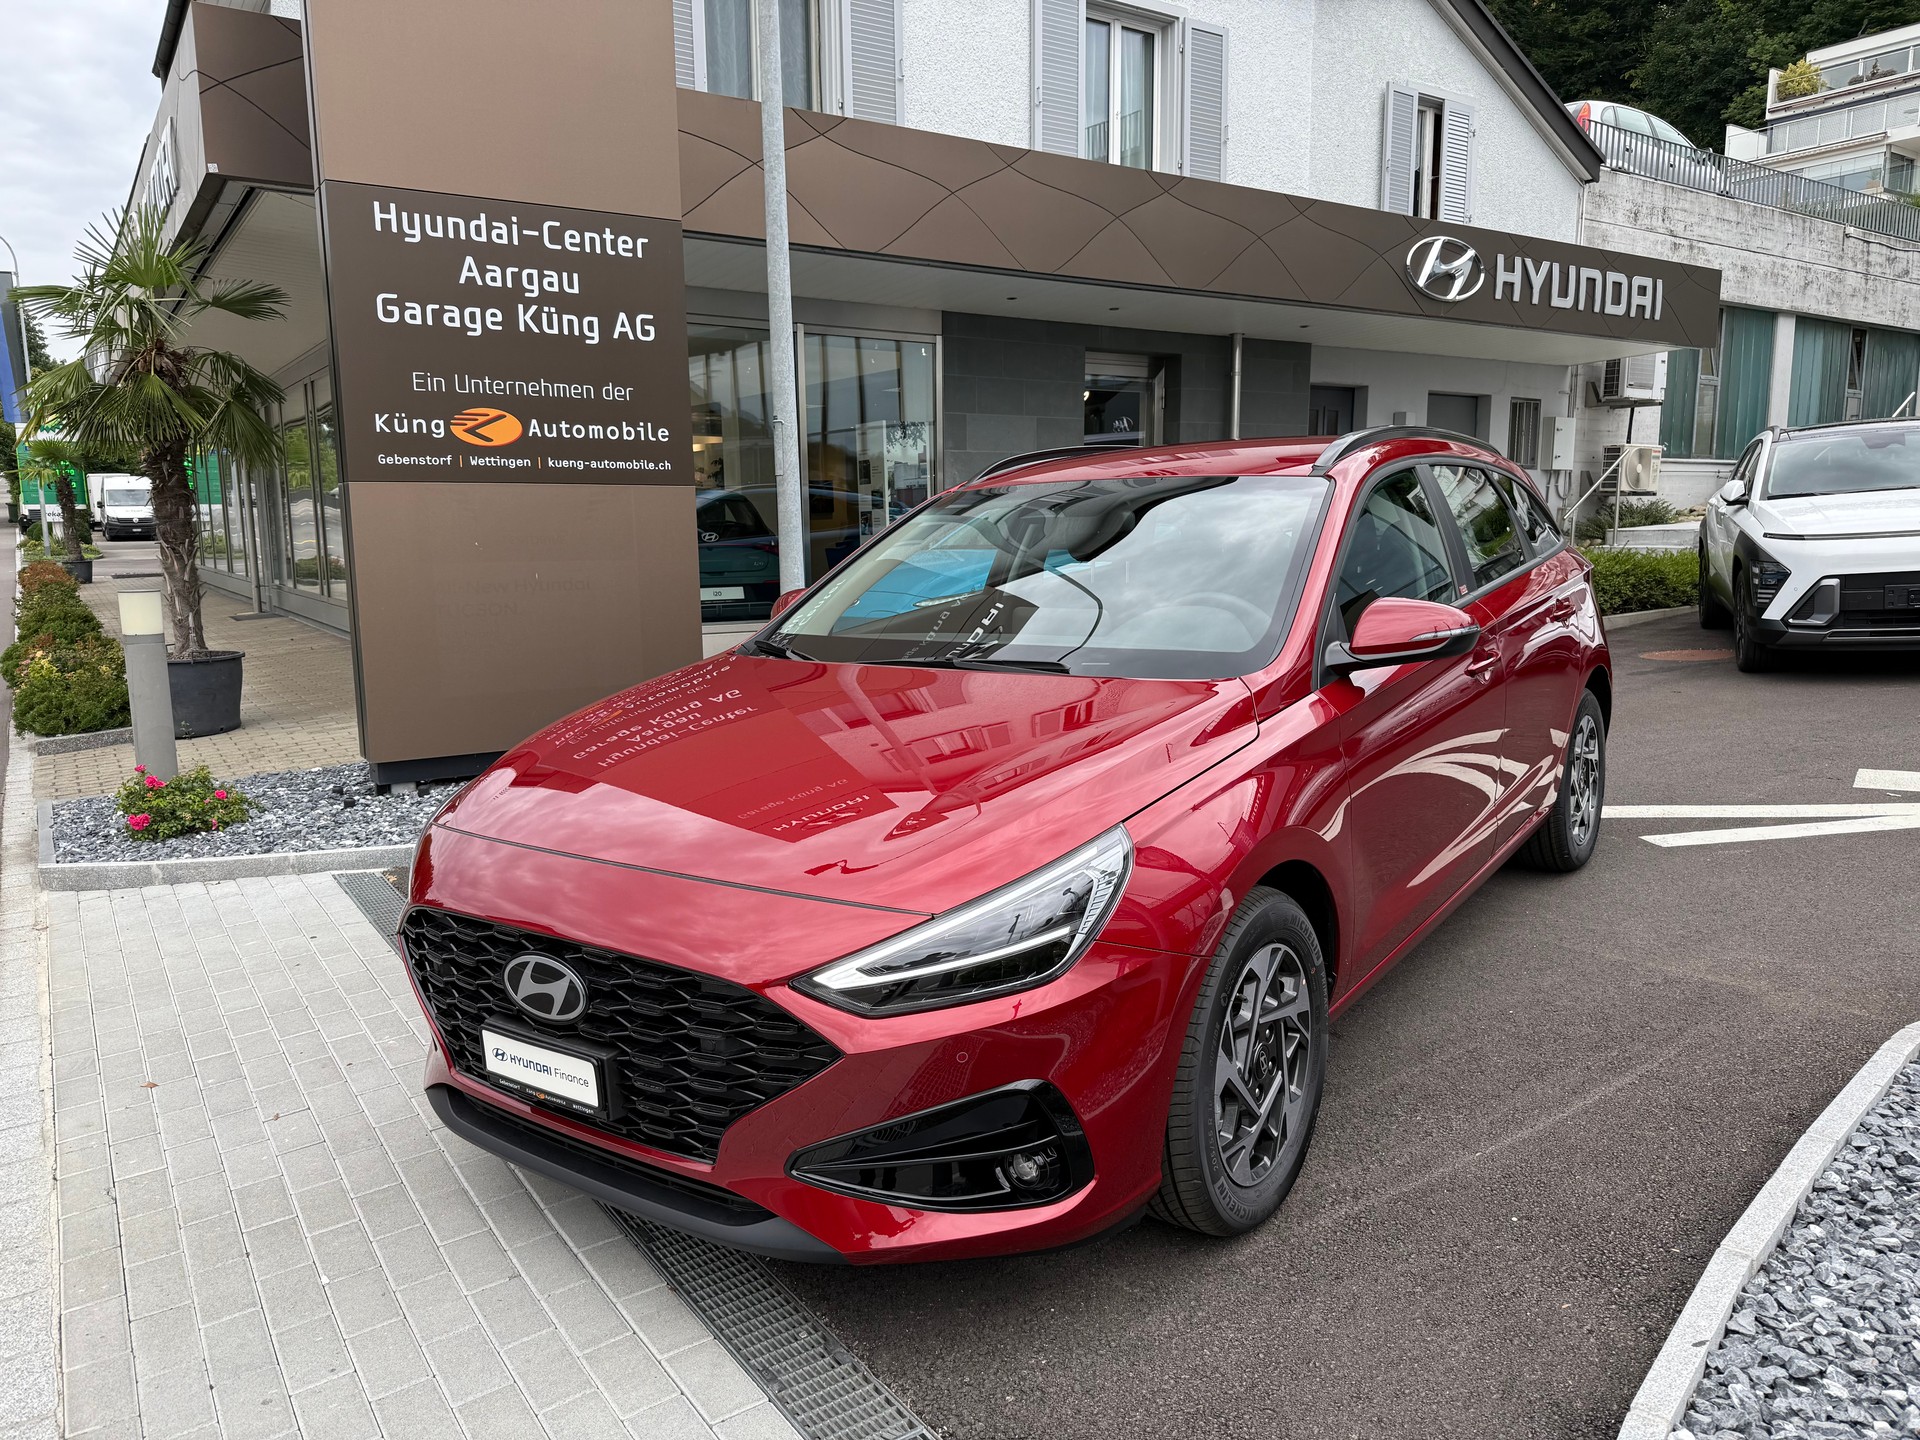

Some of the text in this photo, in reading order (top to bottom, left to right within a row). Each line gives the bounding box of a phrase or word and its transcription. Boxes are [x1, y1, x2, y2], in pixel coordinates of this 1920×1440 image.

[373, 200, 649, 258] Hyundai-Center
[458, 255, 580, 297] Aargau
[1494, 253, 1663, 321] HYUNDAI
[376, 292, 656, 345] Garage Küng AG
[412, 371, 634, 402] Ein Unternehmen der
[374, 413, 670, 442] Küng Automobile
[377, 454, 672, 471] Gebenstorf Wettingen kueng-automobile.ch
[1290, 913, 1322, 963] MICHELIN
[510, 1053, 589, 1088] HYUNDAI Finance
[1216, 1181, 1262, 1222] MICHELIN
